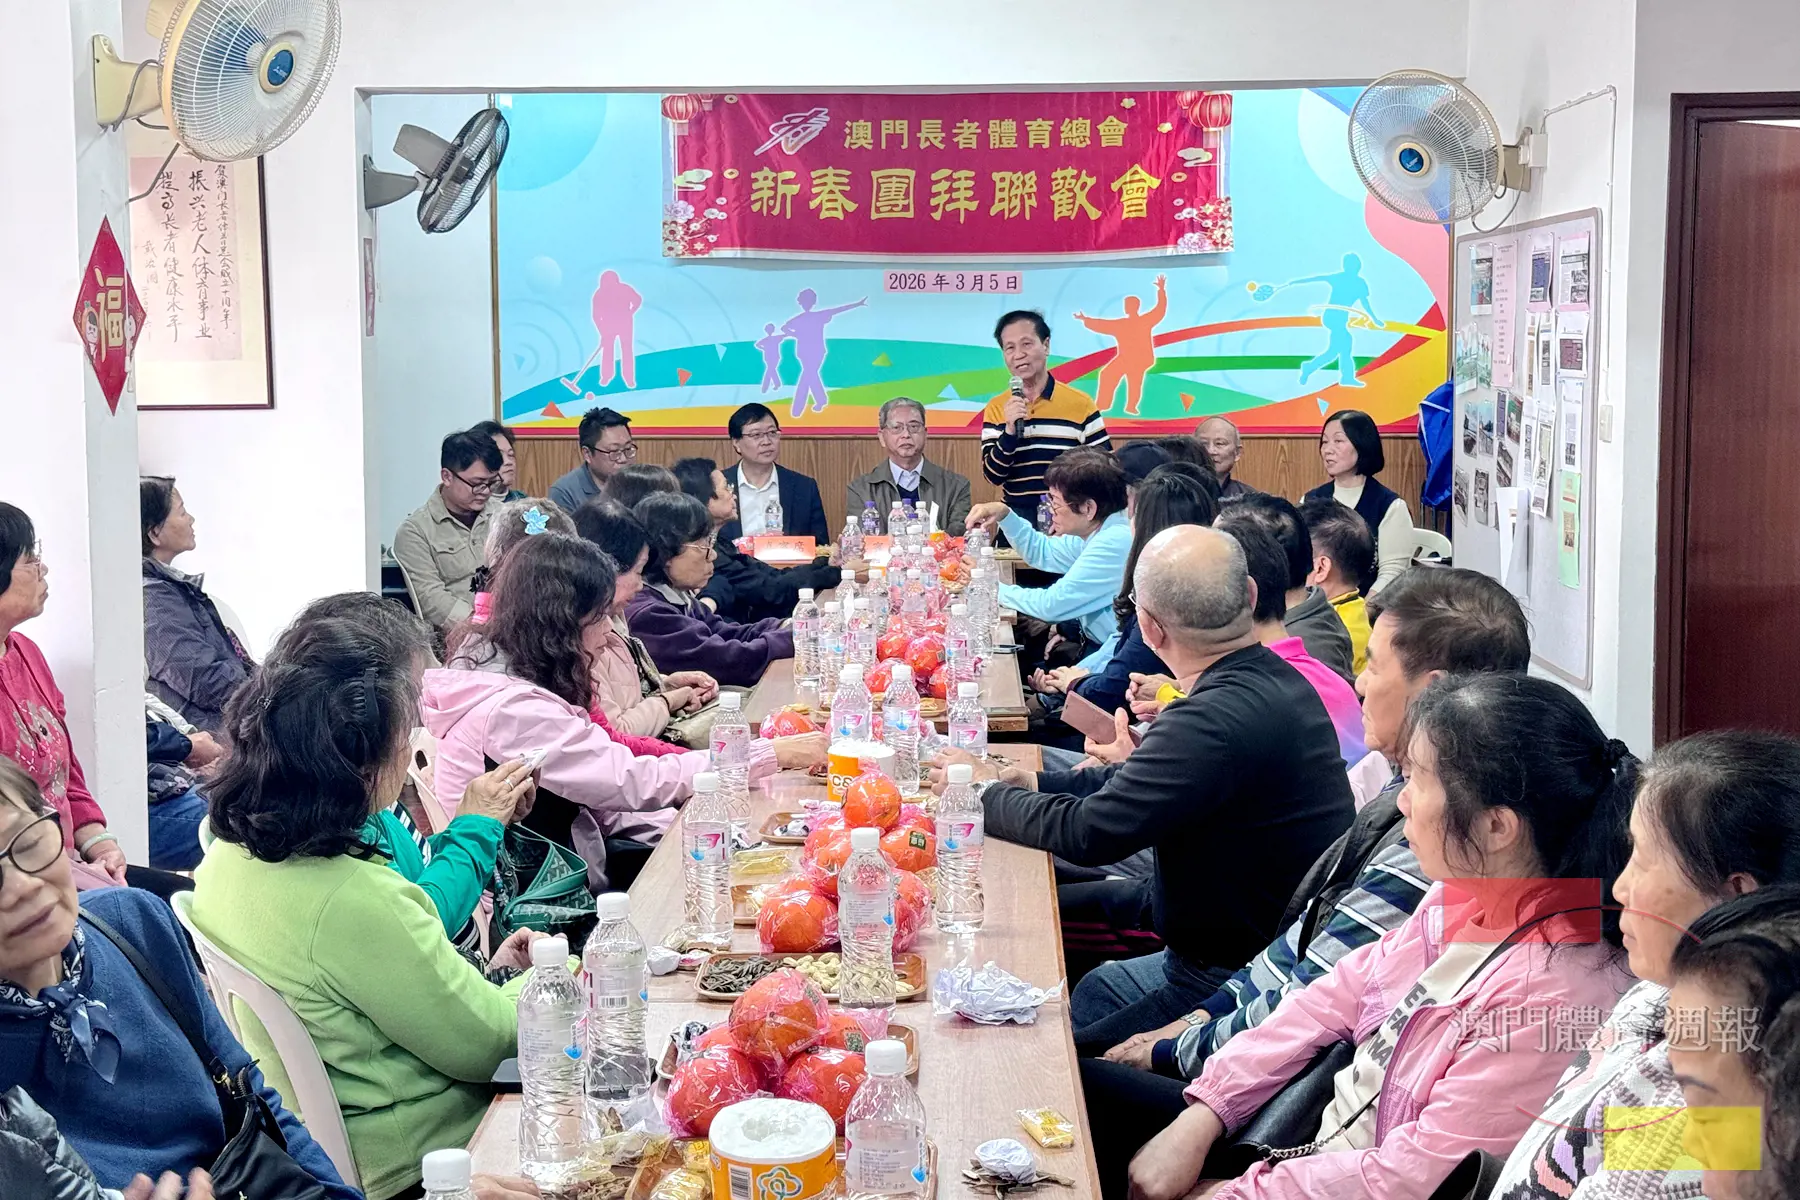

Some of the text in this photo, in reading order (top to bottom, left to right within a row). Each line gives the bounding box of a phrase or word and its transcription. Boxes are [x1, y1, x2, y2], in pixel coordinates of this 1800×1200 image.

[843, 115, 1128, 149] 澳門長者體育總會
[750, 164, 1162, 222] 新春團拜聯歡會
[94, 267, 124, 363] 福
